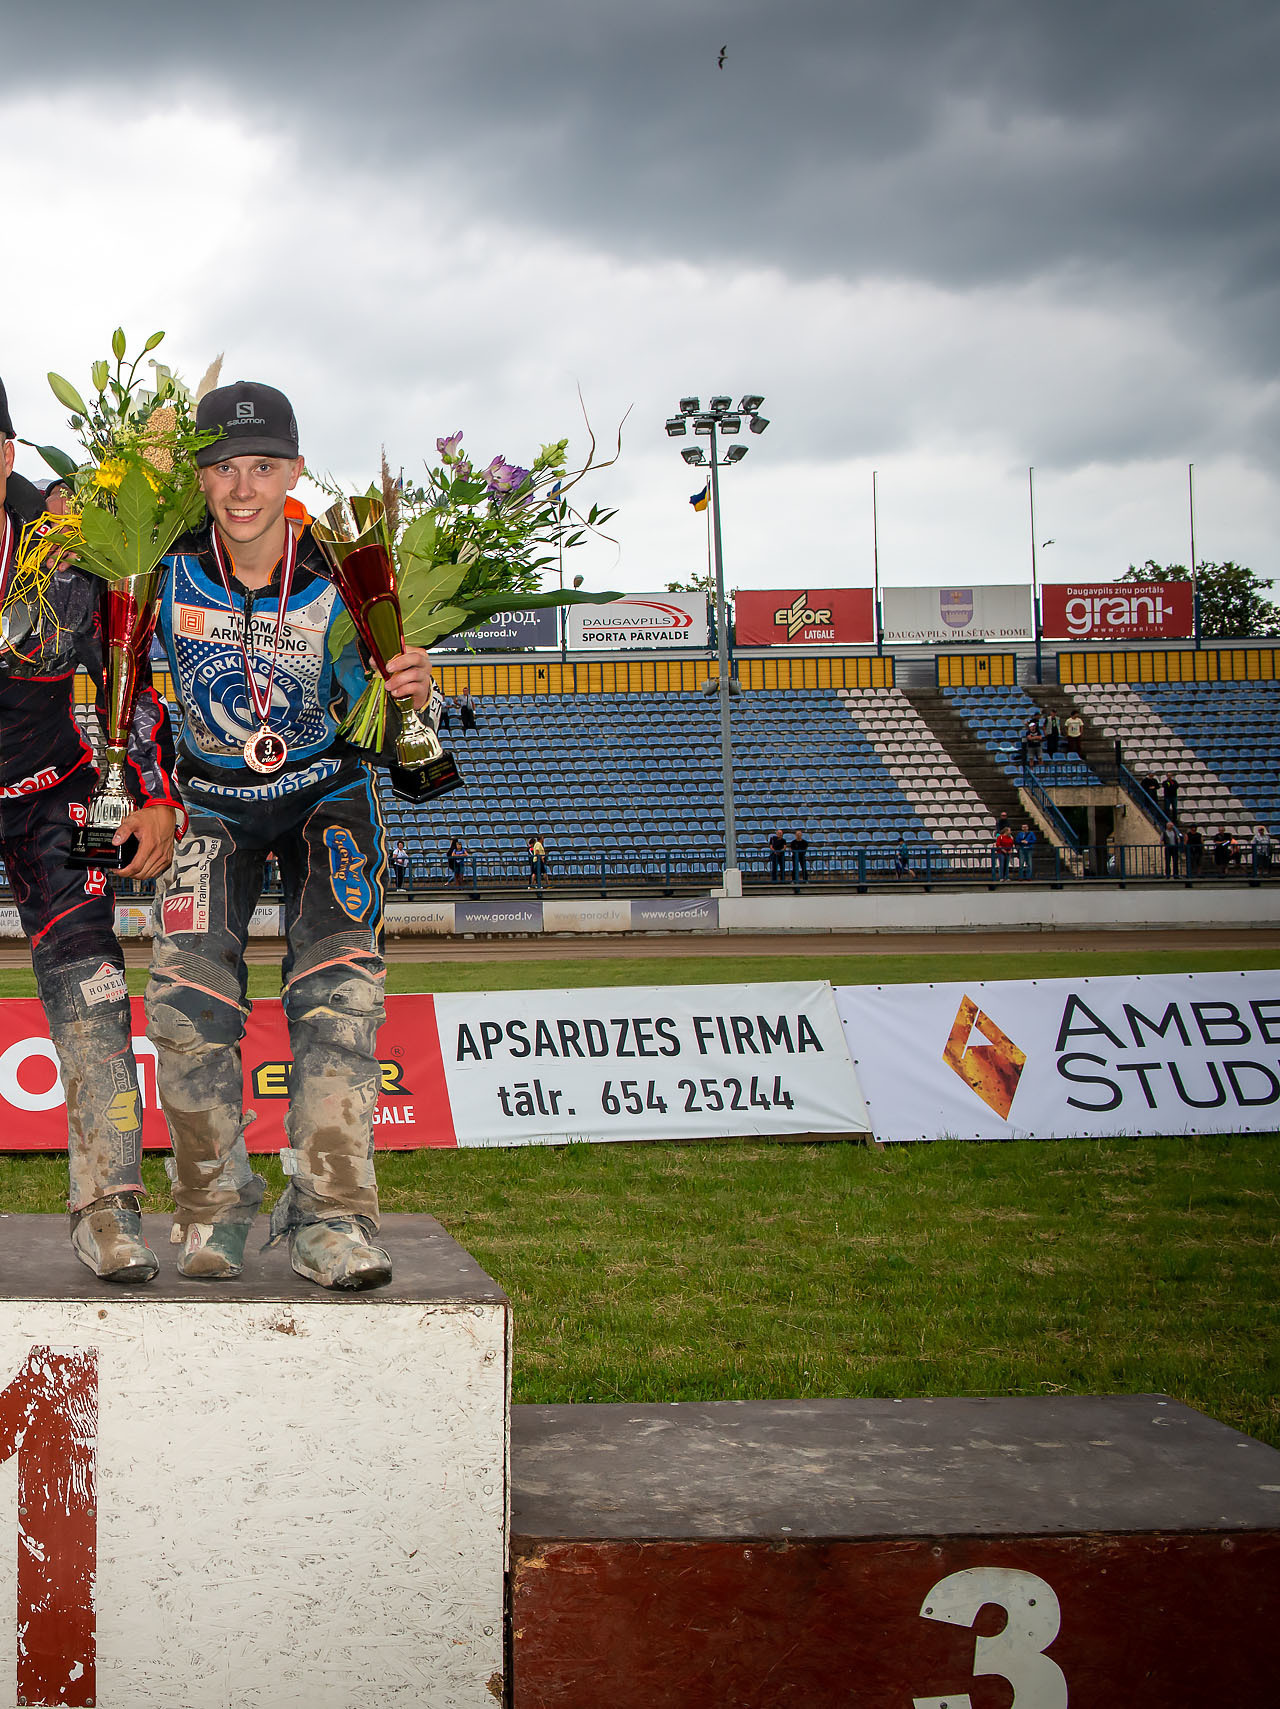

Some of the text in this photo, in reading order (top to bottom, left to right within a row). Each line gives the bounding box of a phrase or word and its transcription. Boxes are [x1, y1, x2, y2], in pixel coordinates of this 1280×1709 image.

[1067, 588, 1113, 596] Daugavpils
[1136, 588, 1164, 597] portāls
[582, 616, 671, 627] DAUGAVPILS
[1066, 596, 1164, 634] grani
[582, 629, 689, 642] SPORTA PĀRVALDE
[804, 629, 835, 639] LATGALE
[888, 628, 1029, 639] DAUGAVPILS PILSĒTAS DOME
[538, 669, 545, 679] K
[197, 871, 208, 907] Training
[197, 910, 206, 930] Fire
[465, 911, 532, 924] www.gorod.lv
[641, 907, 709, 921] www.gorod.lv
[456, 1014, 825, 1061] APSARDZES FIRMA
[1056, 1052, 1280, 1112] STUD
[498, 1075, 795, 1117] tālr. 654 25244
[373, 1105, 416, 1124] GALE
[914, 1567, 1069, 1709] 3
